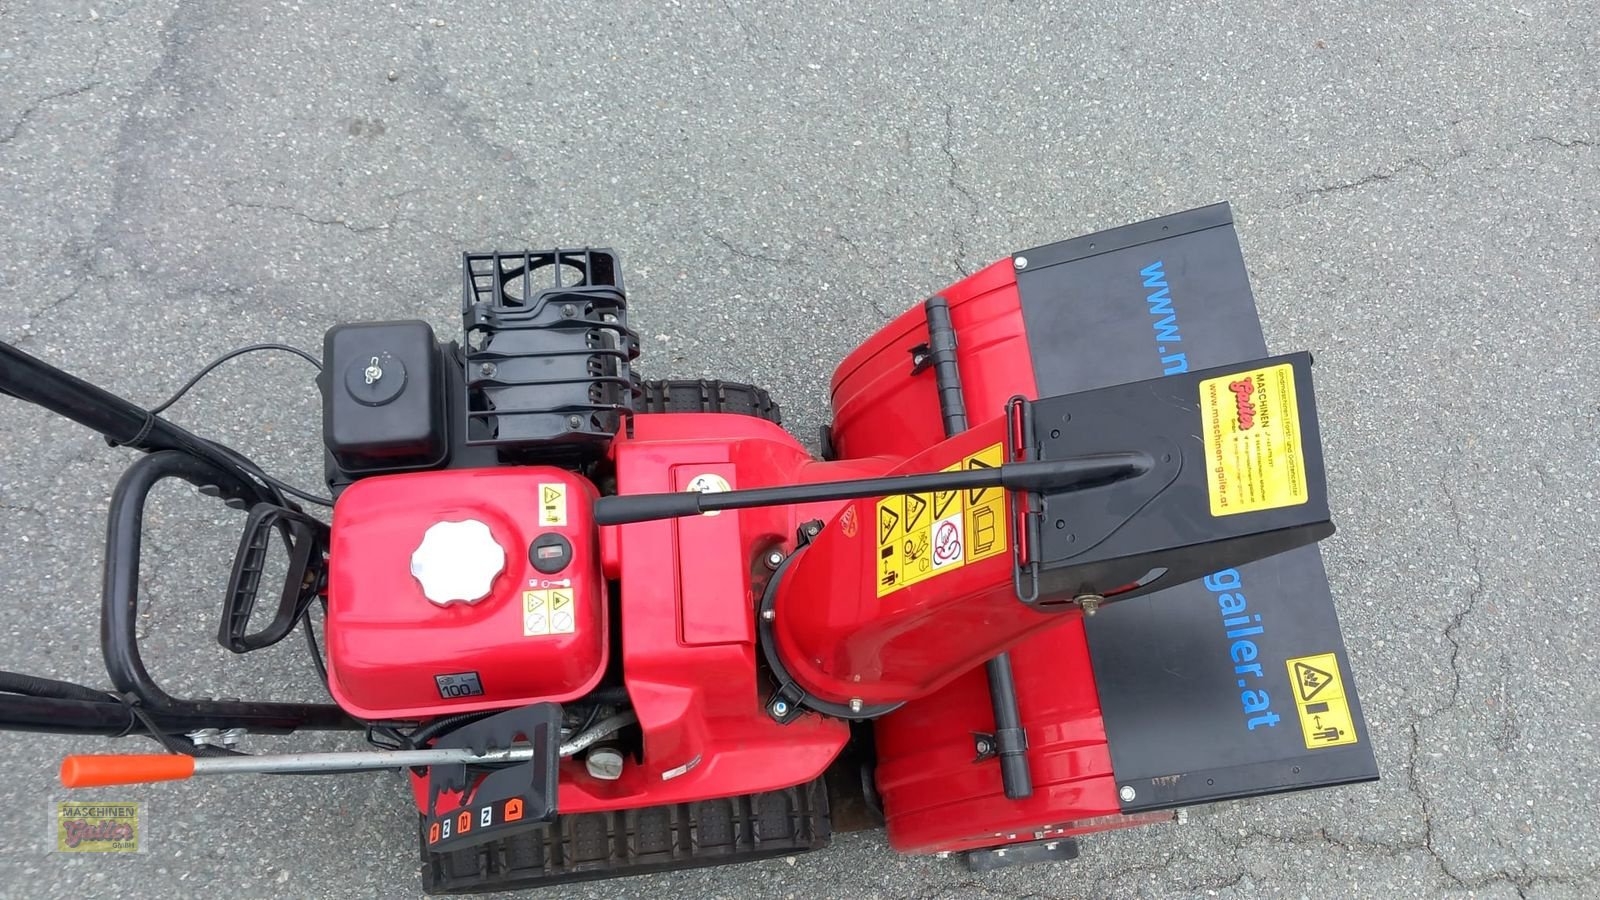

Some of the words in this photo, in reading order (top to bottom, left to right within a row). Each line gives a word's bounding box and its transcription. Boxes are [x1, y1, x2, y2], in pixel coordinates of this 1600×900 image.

[1229, 377, 1256, 431] Gailer
[1257, 374, 1269, 428] MASCHINEN
[1278, 369, 1289, 416] Landmaschinen
[1209, 384, 1228, 507] www.maschinen-gailer.at
[442, 684, 471, 697] 100
